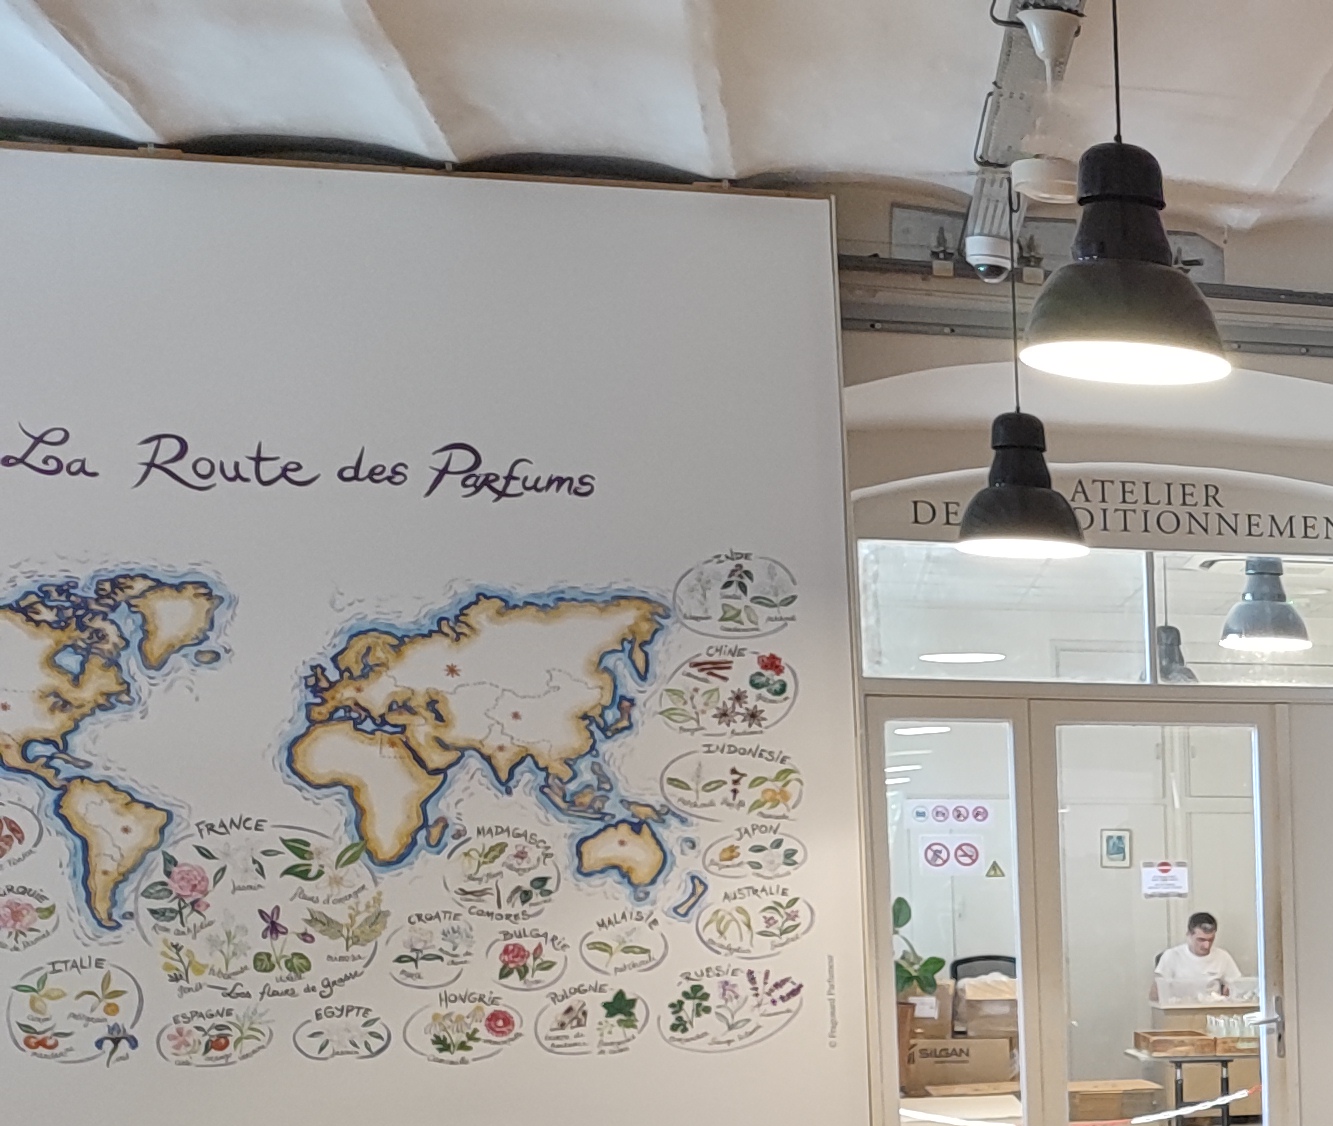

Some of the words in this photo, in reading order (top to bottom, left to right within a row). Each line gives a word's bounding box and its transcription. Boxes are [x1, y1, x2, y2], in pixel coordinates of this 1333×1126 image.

[1, 420, 99, 477] La
[132, 433, 321, 491] Route
[337, 446, 409, 485] des
[424, 442, 596, 502] Parfums
[1070, 479, 1224, 508] ATELIER
[910, 500, 960, 526] DE
[713, 549, 753, 565] INDE
[195, 815, 269, 840] FRANCE
[735, 823, 781, 841] JAPON
[722, 885, 790, 903] AUSTRALIE
[407, 911, 464, 925] CROATIE
[468, 905, 531, 924] COMORES
[595, 911, 661, 932] MALAISIE
[47, 957, 107, 975] ITALIE
[172, 1008, 235, 1026] ESPAGNE
[314, 1005, 374, 1021] EGYPTE
[918, 1047, 970, 1059] SILGAN
